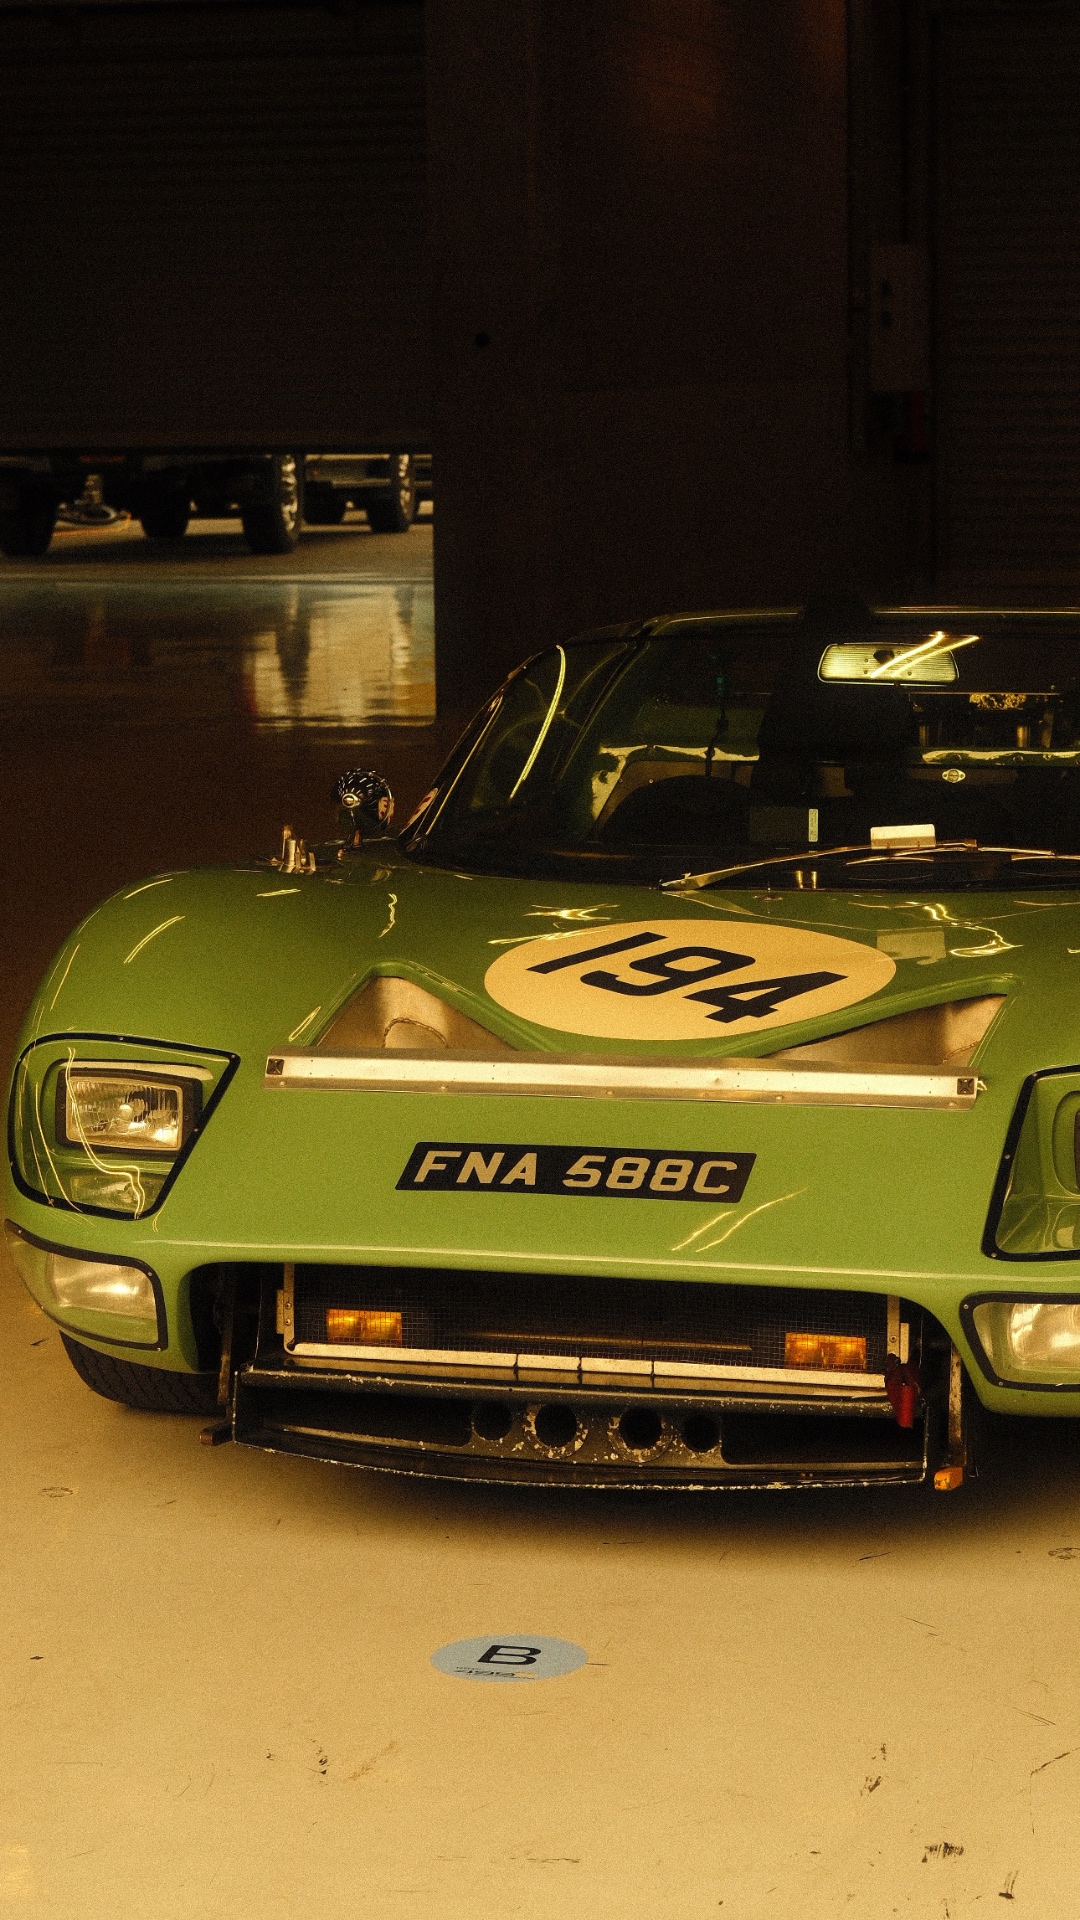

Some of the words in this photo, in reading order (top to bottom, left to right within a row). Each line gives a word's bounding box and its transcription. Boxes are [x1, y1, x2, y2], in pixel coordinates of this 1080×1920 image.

[526, 931, 848, 1023] 194
[413, 1150, 538, 1186] FNA
[562, 1154, 738, 1195] 588C
[477, 1644, 542, 1666] B
